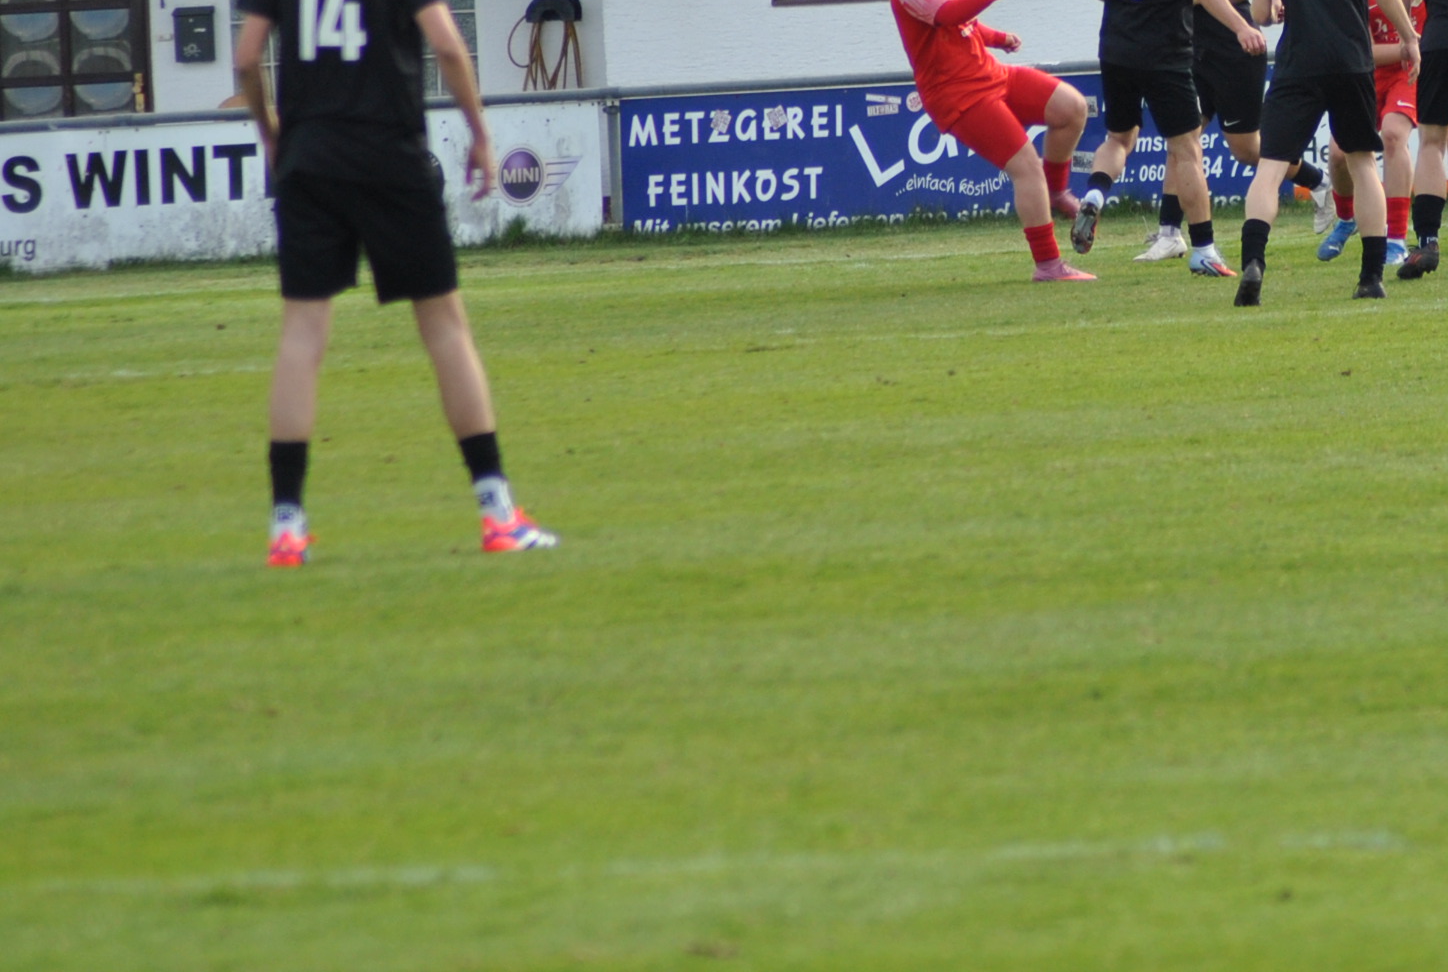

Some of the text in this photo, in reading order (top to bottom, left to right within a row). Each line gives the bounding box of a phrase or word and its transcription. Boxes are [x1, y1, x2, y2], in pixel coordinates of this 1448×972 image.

[629, 104, 843, 147] METZGEREI
[66, 143, 276, 210] WINT
[502, 166, 540, 184] MINI
[647, 166, 823, 208] FEINKOST
